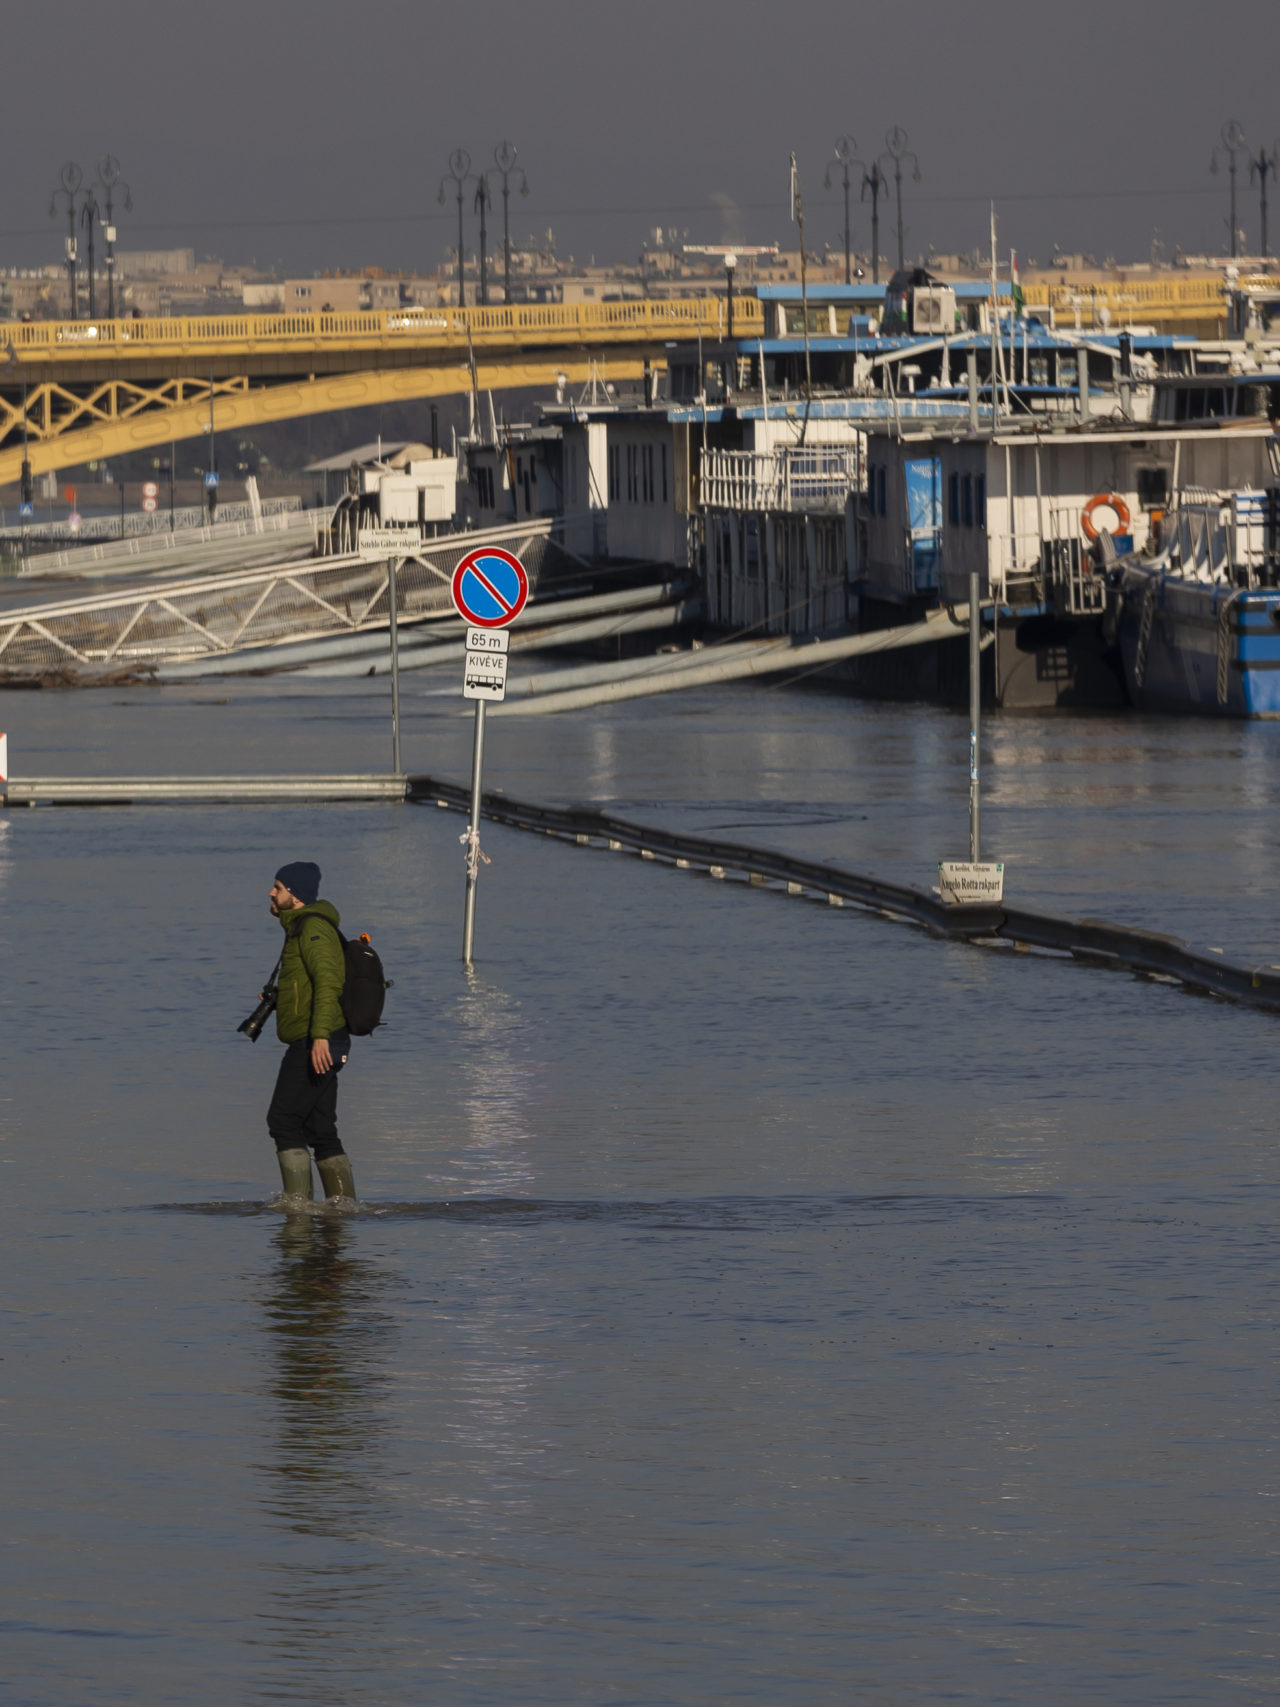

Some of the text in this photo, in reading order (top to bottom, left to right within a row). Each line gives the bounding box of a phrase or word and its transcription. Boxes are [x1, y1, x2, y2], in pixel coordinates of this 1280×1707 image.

[471, 633, 501, 648] 65 m
[469, 655, 504, 669] KIVÉVE
[961, 878, 978, 890] Rotta
[979, 878, 1000, 893] rakpart
